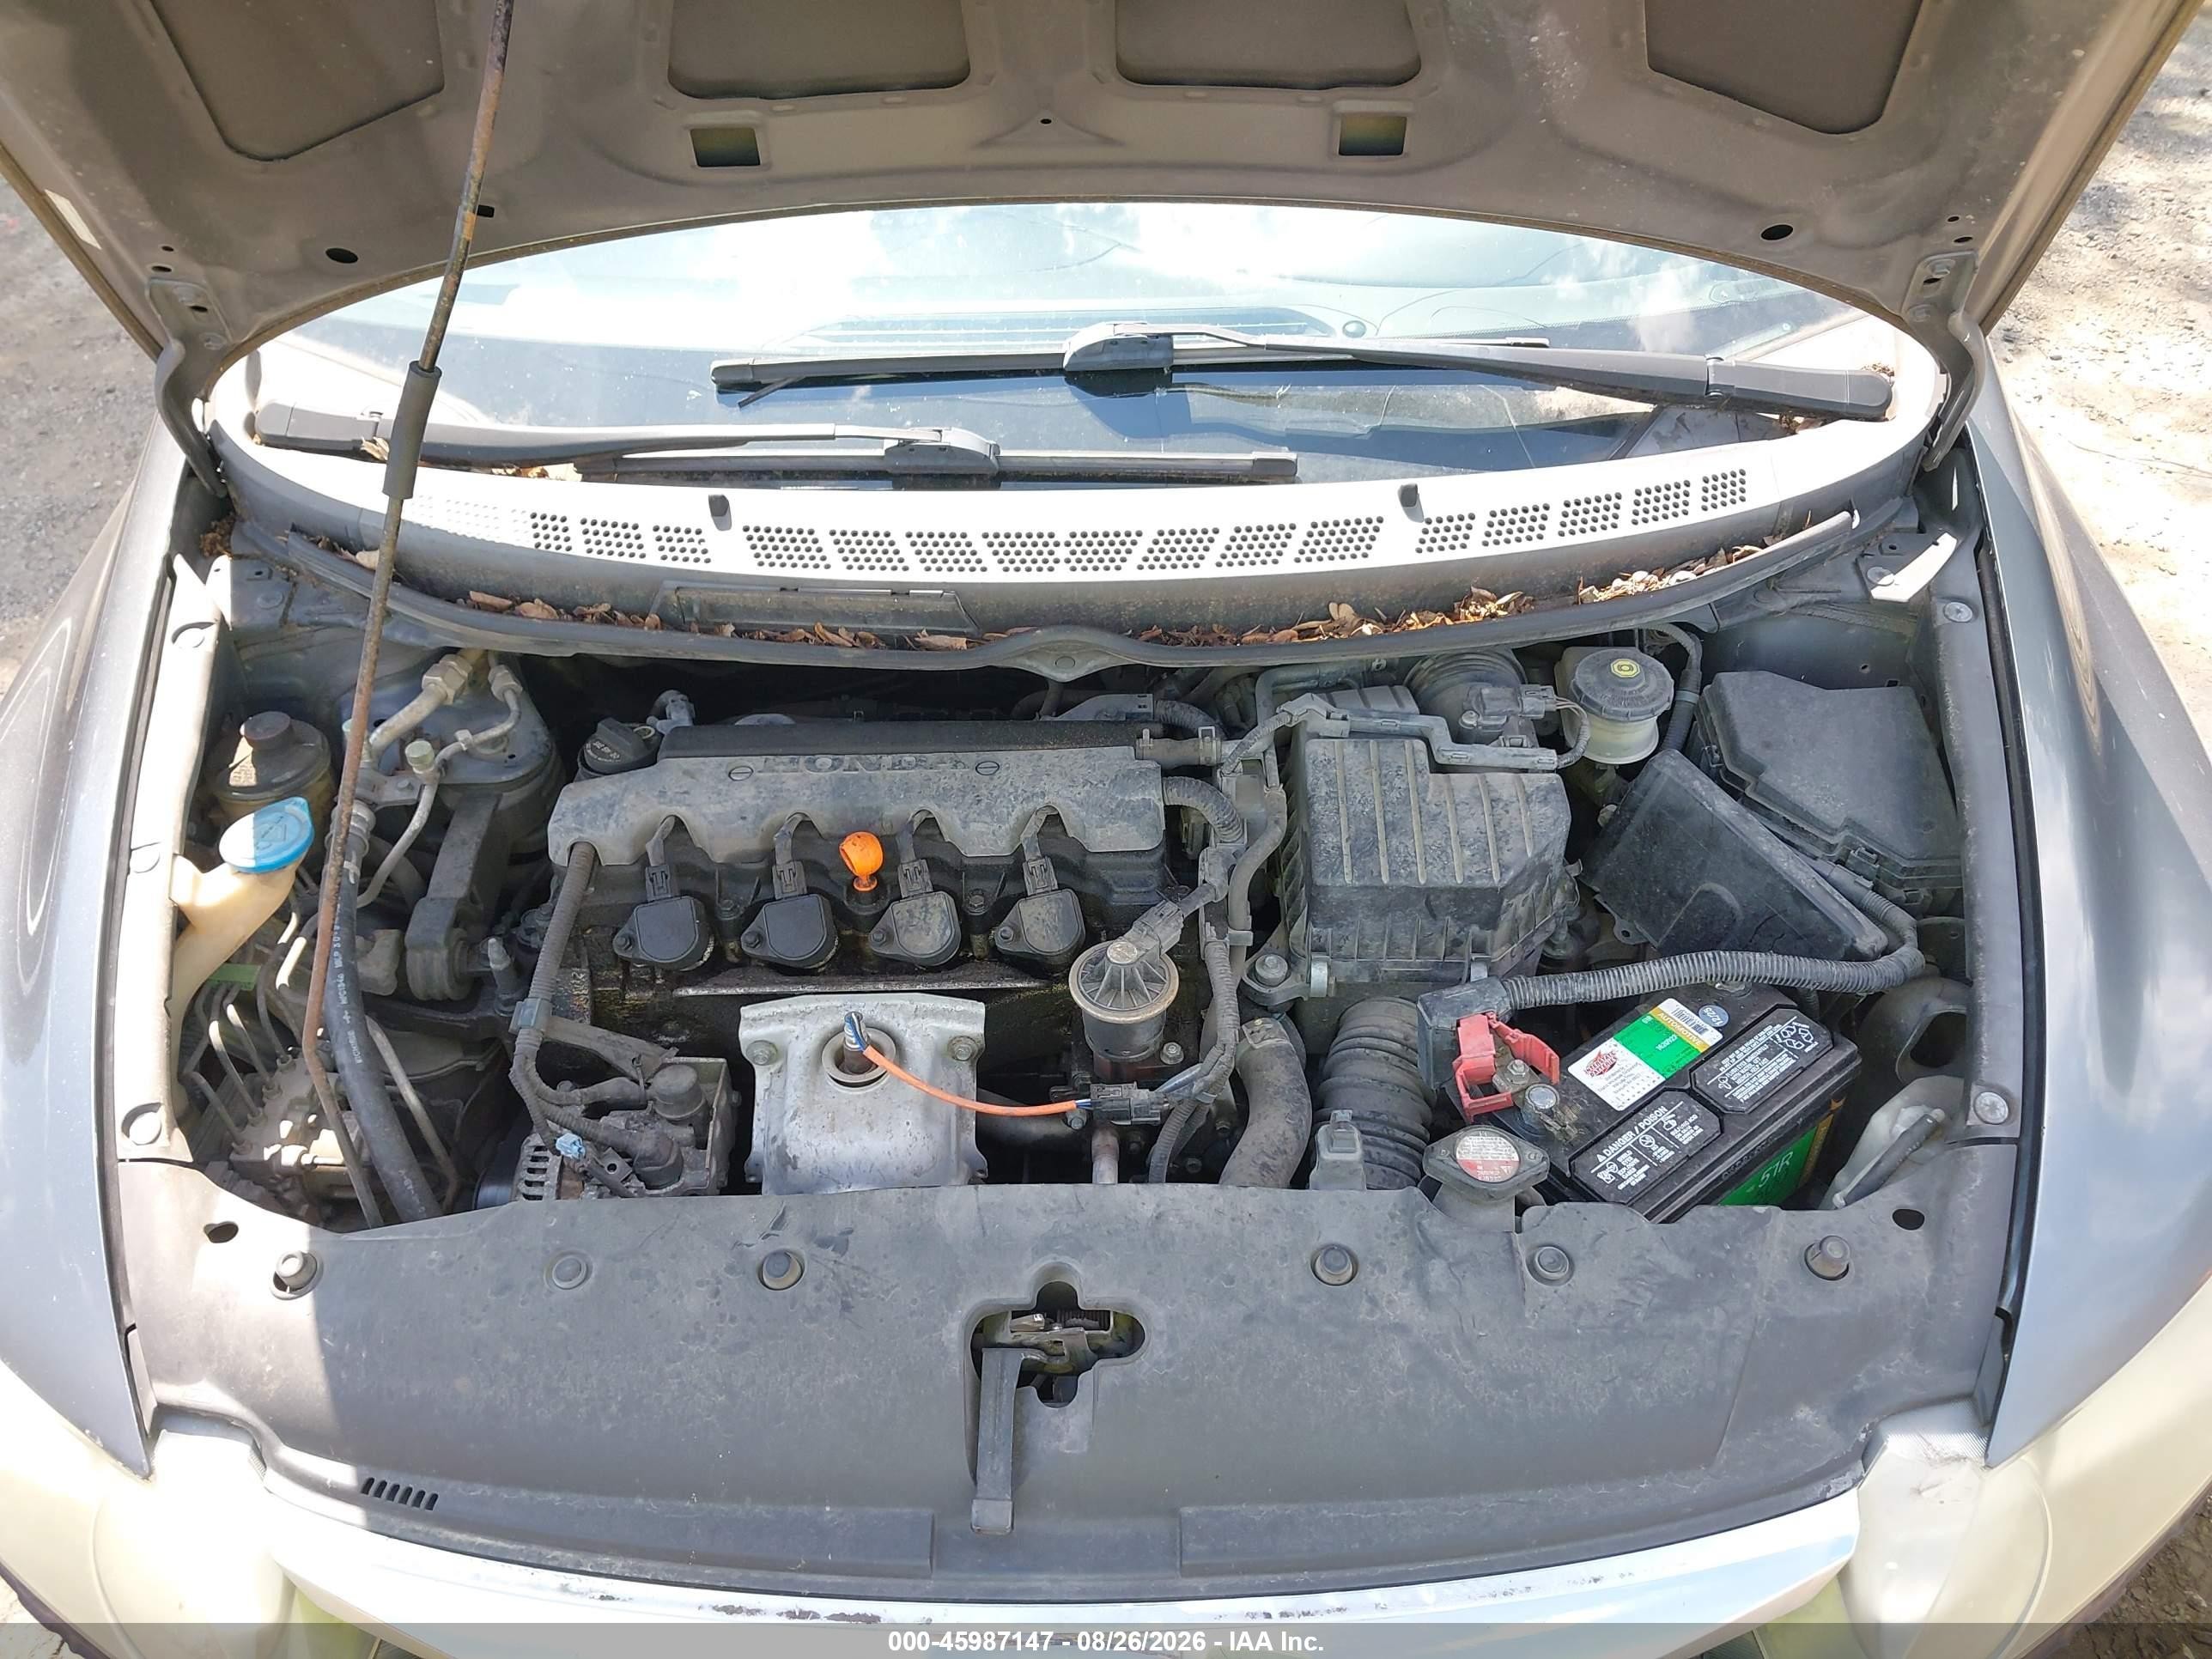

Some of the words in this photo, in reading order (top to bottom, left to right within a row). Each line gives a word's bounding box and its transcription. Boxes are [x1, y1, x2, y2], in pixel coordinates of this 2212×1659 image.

[758, 755, 969, 774] HONDA
[1704, 1007, 1724, 1025] 12/25
[1657, 1012, 1704, 1045] AUTOMOTIVE
[1583, 1050, 1615, 1073] INTERSTATE
[1589, 1055, 1617, 1077] BATTERIES
[1602, 1132, 1637, 1157] DANGER
[1640, 1105, 1668, 1129] POISON
